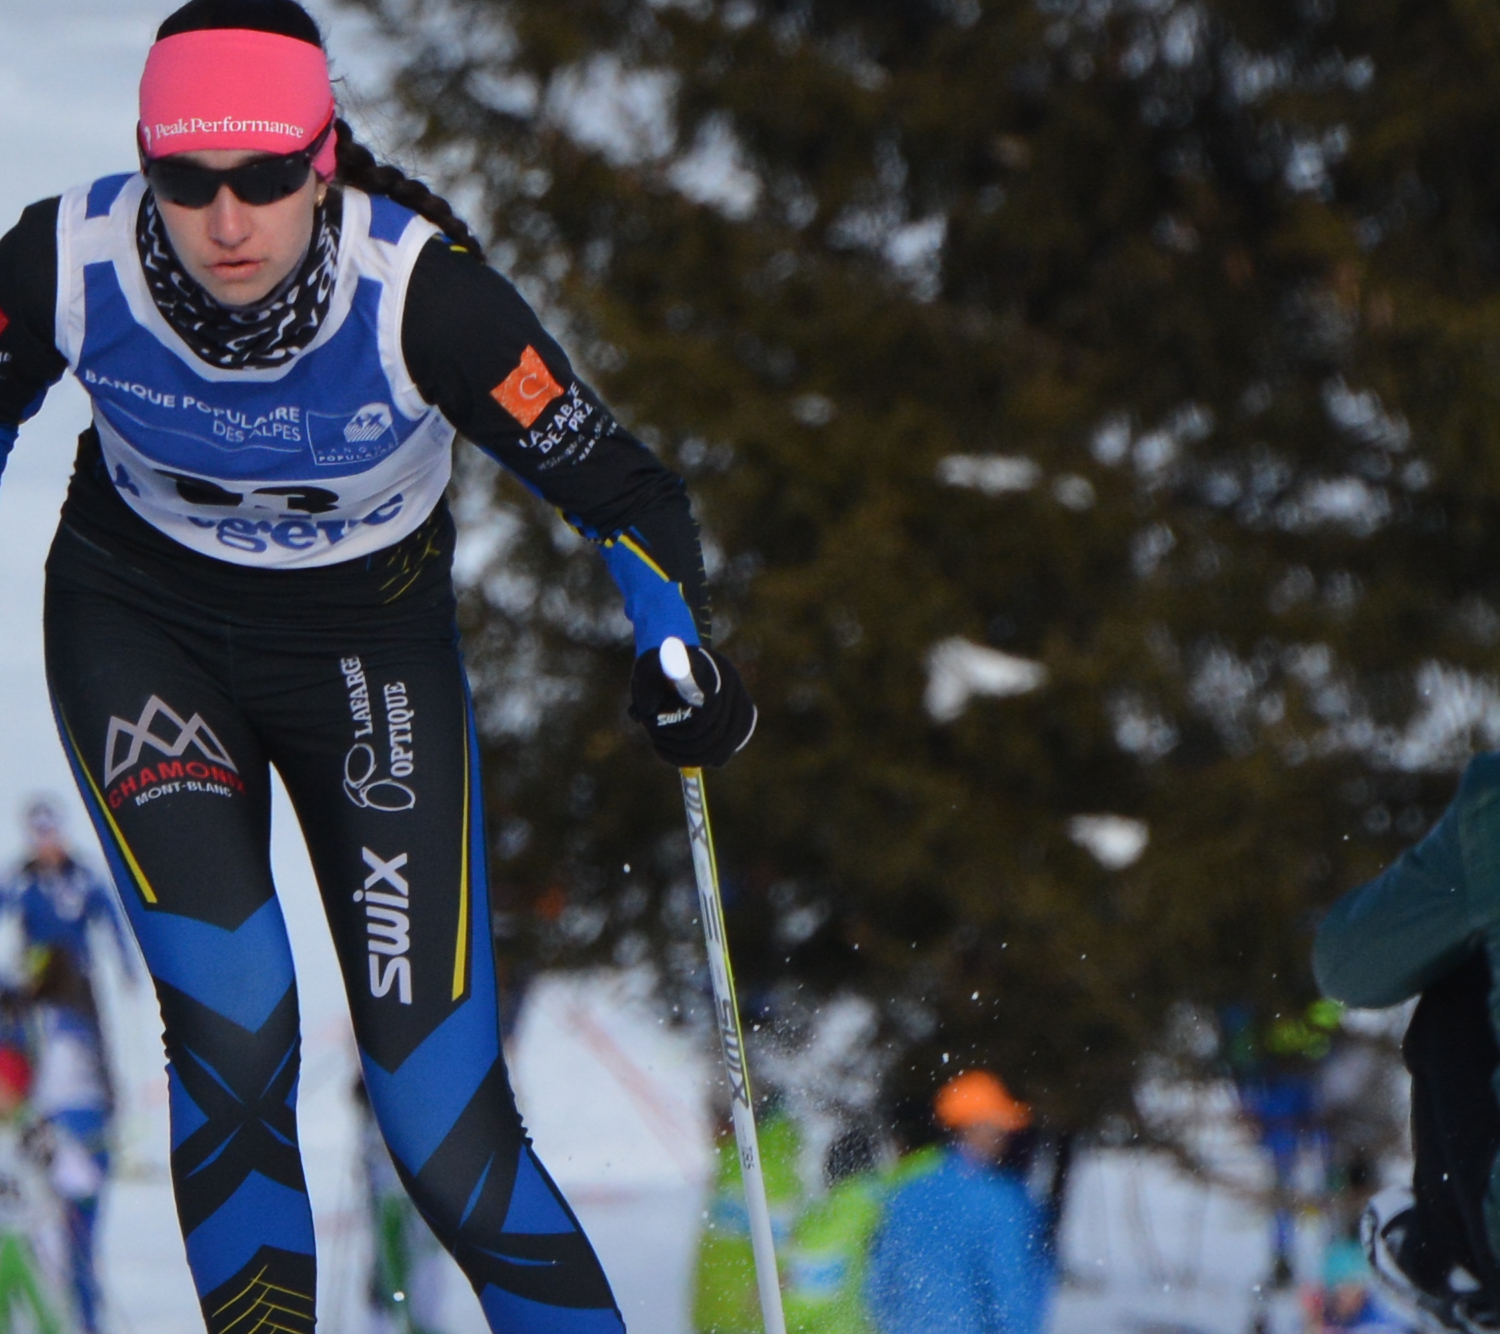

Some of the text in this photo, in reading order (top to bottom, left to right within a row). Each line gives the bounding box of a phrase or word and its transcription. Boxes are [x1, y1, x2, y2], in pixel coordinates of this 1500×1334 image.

[84, 369, 301, 428] BANQUE POPULAIRE
[212, 420, 301, 444] DES ALPES
[341, 655, 374, 740] LAFARGE
[657, 706, 693, 727] swix
[383, 681, 415, 778] OPTIQUE
[134, 780, 233, 807] MONT-BLANC
[352, 845, 413, 1006] swix
